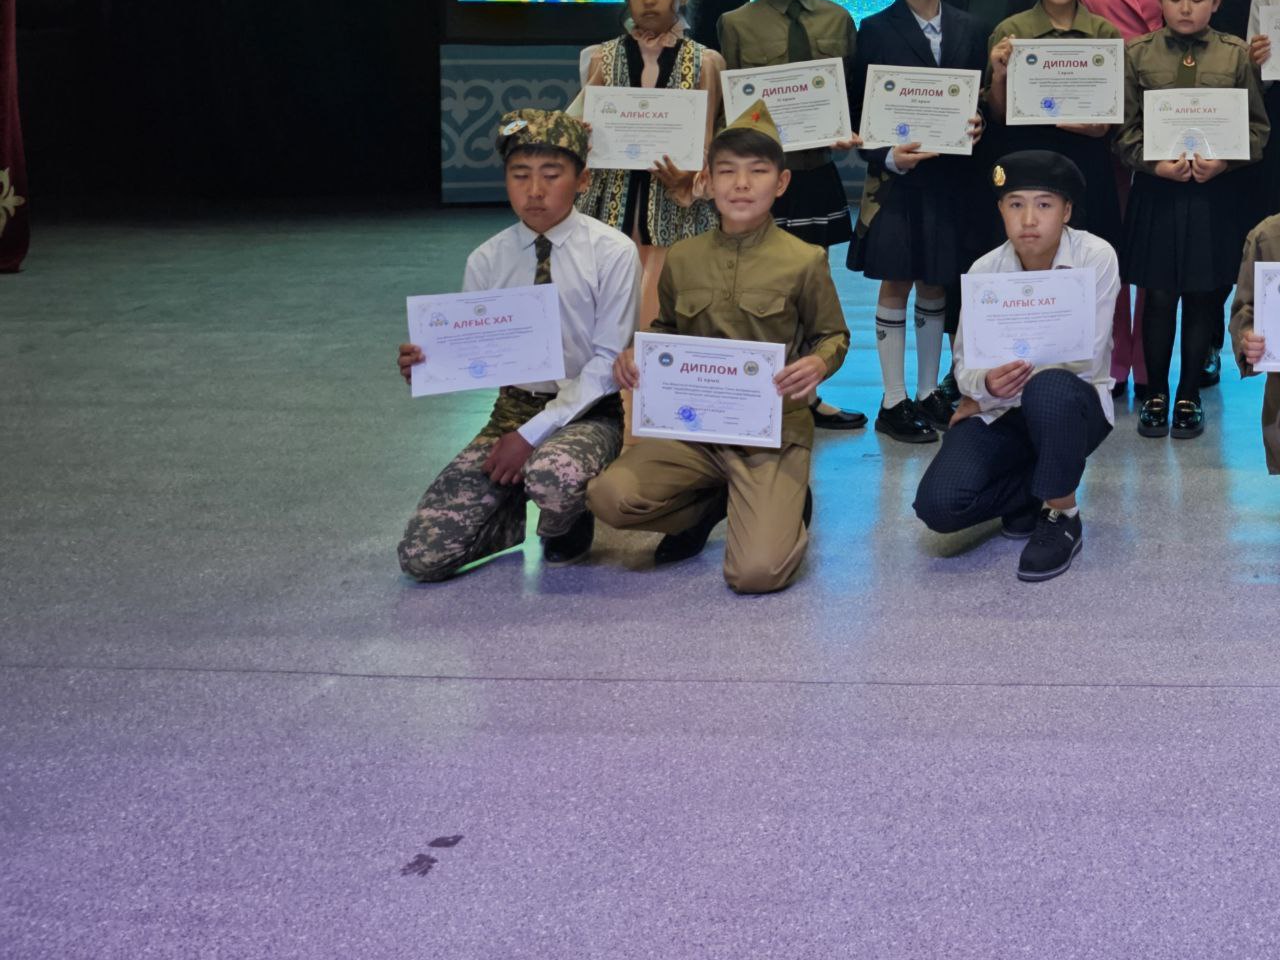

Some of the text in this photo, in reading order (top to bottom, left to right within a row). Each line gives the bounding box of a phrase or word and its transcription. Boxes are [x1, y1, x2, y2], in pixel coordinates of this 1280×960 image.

[1042, 60, 1088, 69] ДИПЛОМ
[762, 84, 808, 98] ДИПЛОМ
[899, 87, 943, 97] ДИПЛОМ
[1038, 297, 1057, 306] ХАТ
[493, 314, 513, 325] ХАТ
[680, 362, 738, 376] ДИПЛОМ
